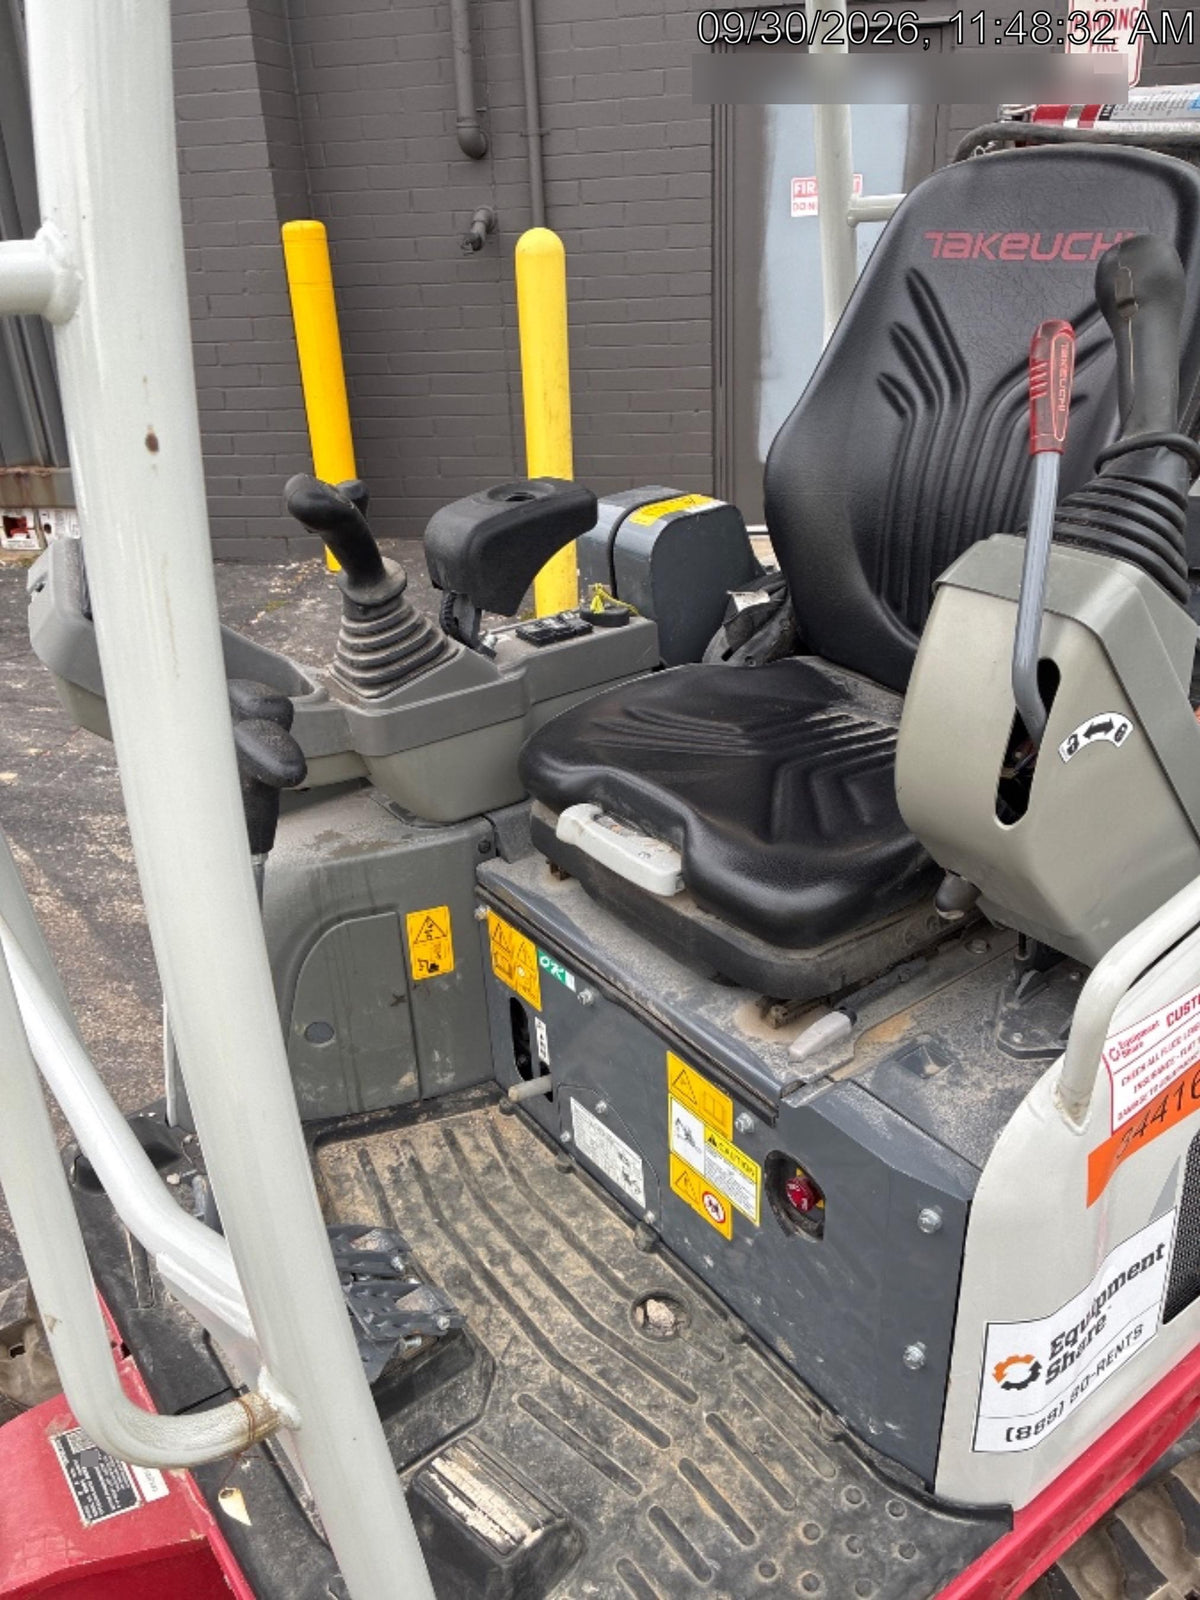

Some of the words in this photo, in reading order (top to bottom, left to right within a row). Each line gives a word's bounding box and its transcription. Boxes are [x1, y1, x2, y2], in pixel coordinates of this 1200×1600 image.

[794, 181, 817, 196] FIR
[923, 231, 1136, 262] TAKEUCH
[539, 955, 566, 981] OK
[1165, 993, 1200, 1028] CUST
[1048, 1243, 1165, 1360] Equipment
[1045, 1314, 1107, 1385] Share
[1006, 1400, 1064, 1442] (888)
